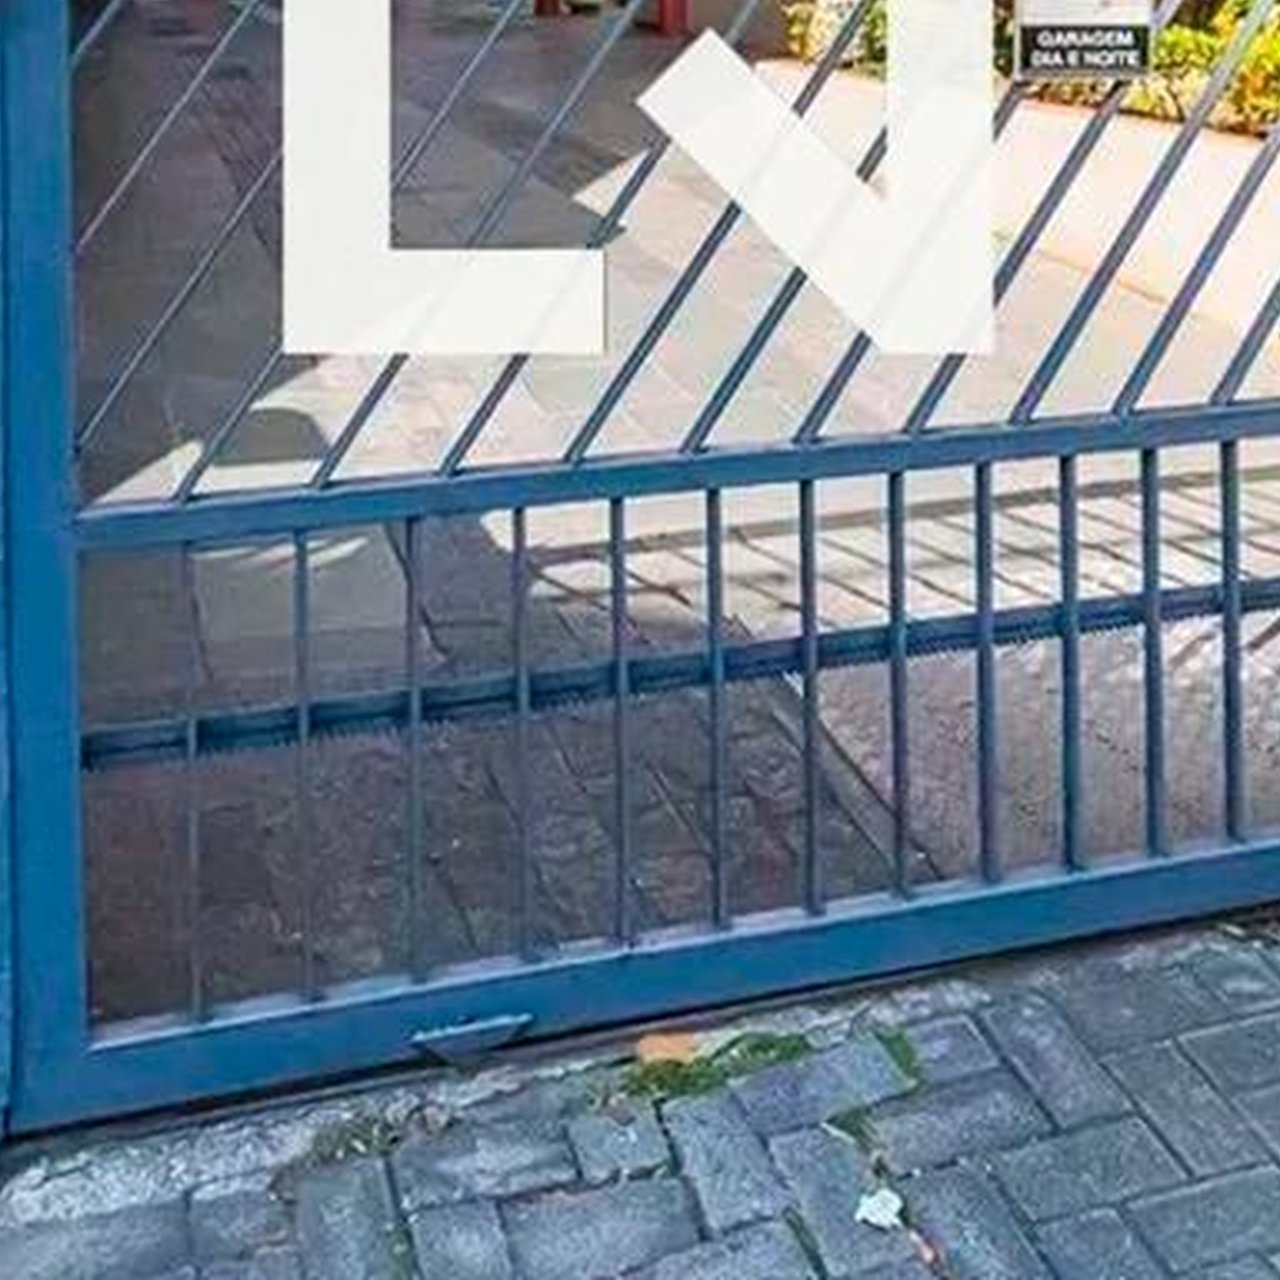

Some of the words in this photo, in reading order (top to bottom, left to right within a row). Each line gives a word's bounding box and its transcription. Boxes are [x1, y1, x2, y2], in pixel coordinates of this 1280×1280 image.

[1036, 28, 1135, 49] GARAGEM
[1030, 50, 1064, 67] DIA
[1067, 51, 1079, 68] E
[1083, 51, 1140, 69] NOITE
